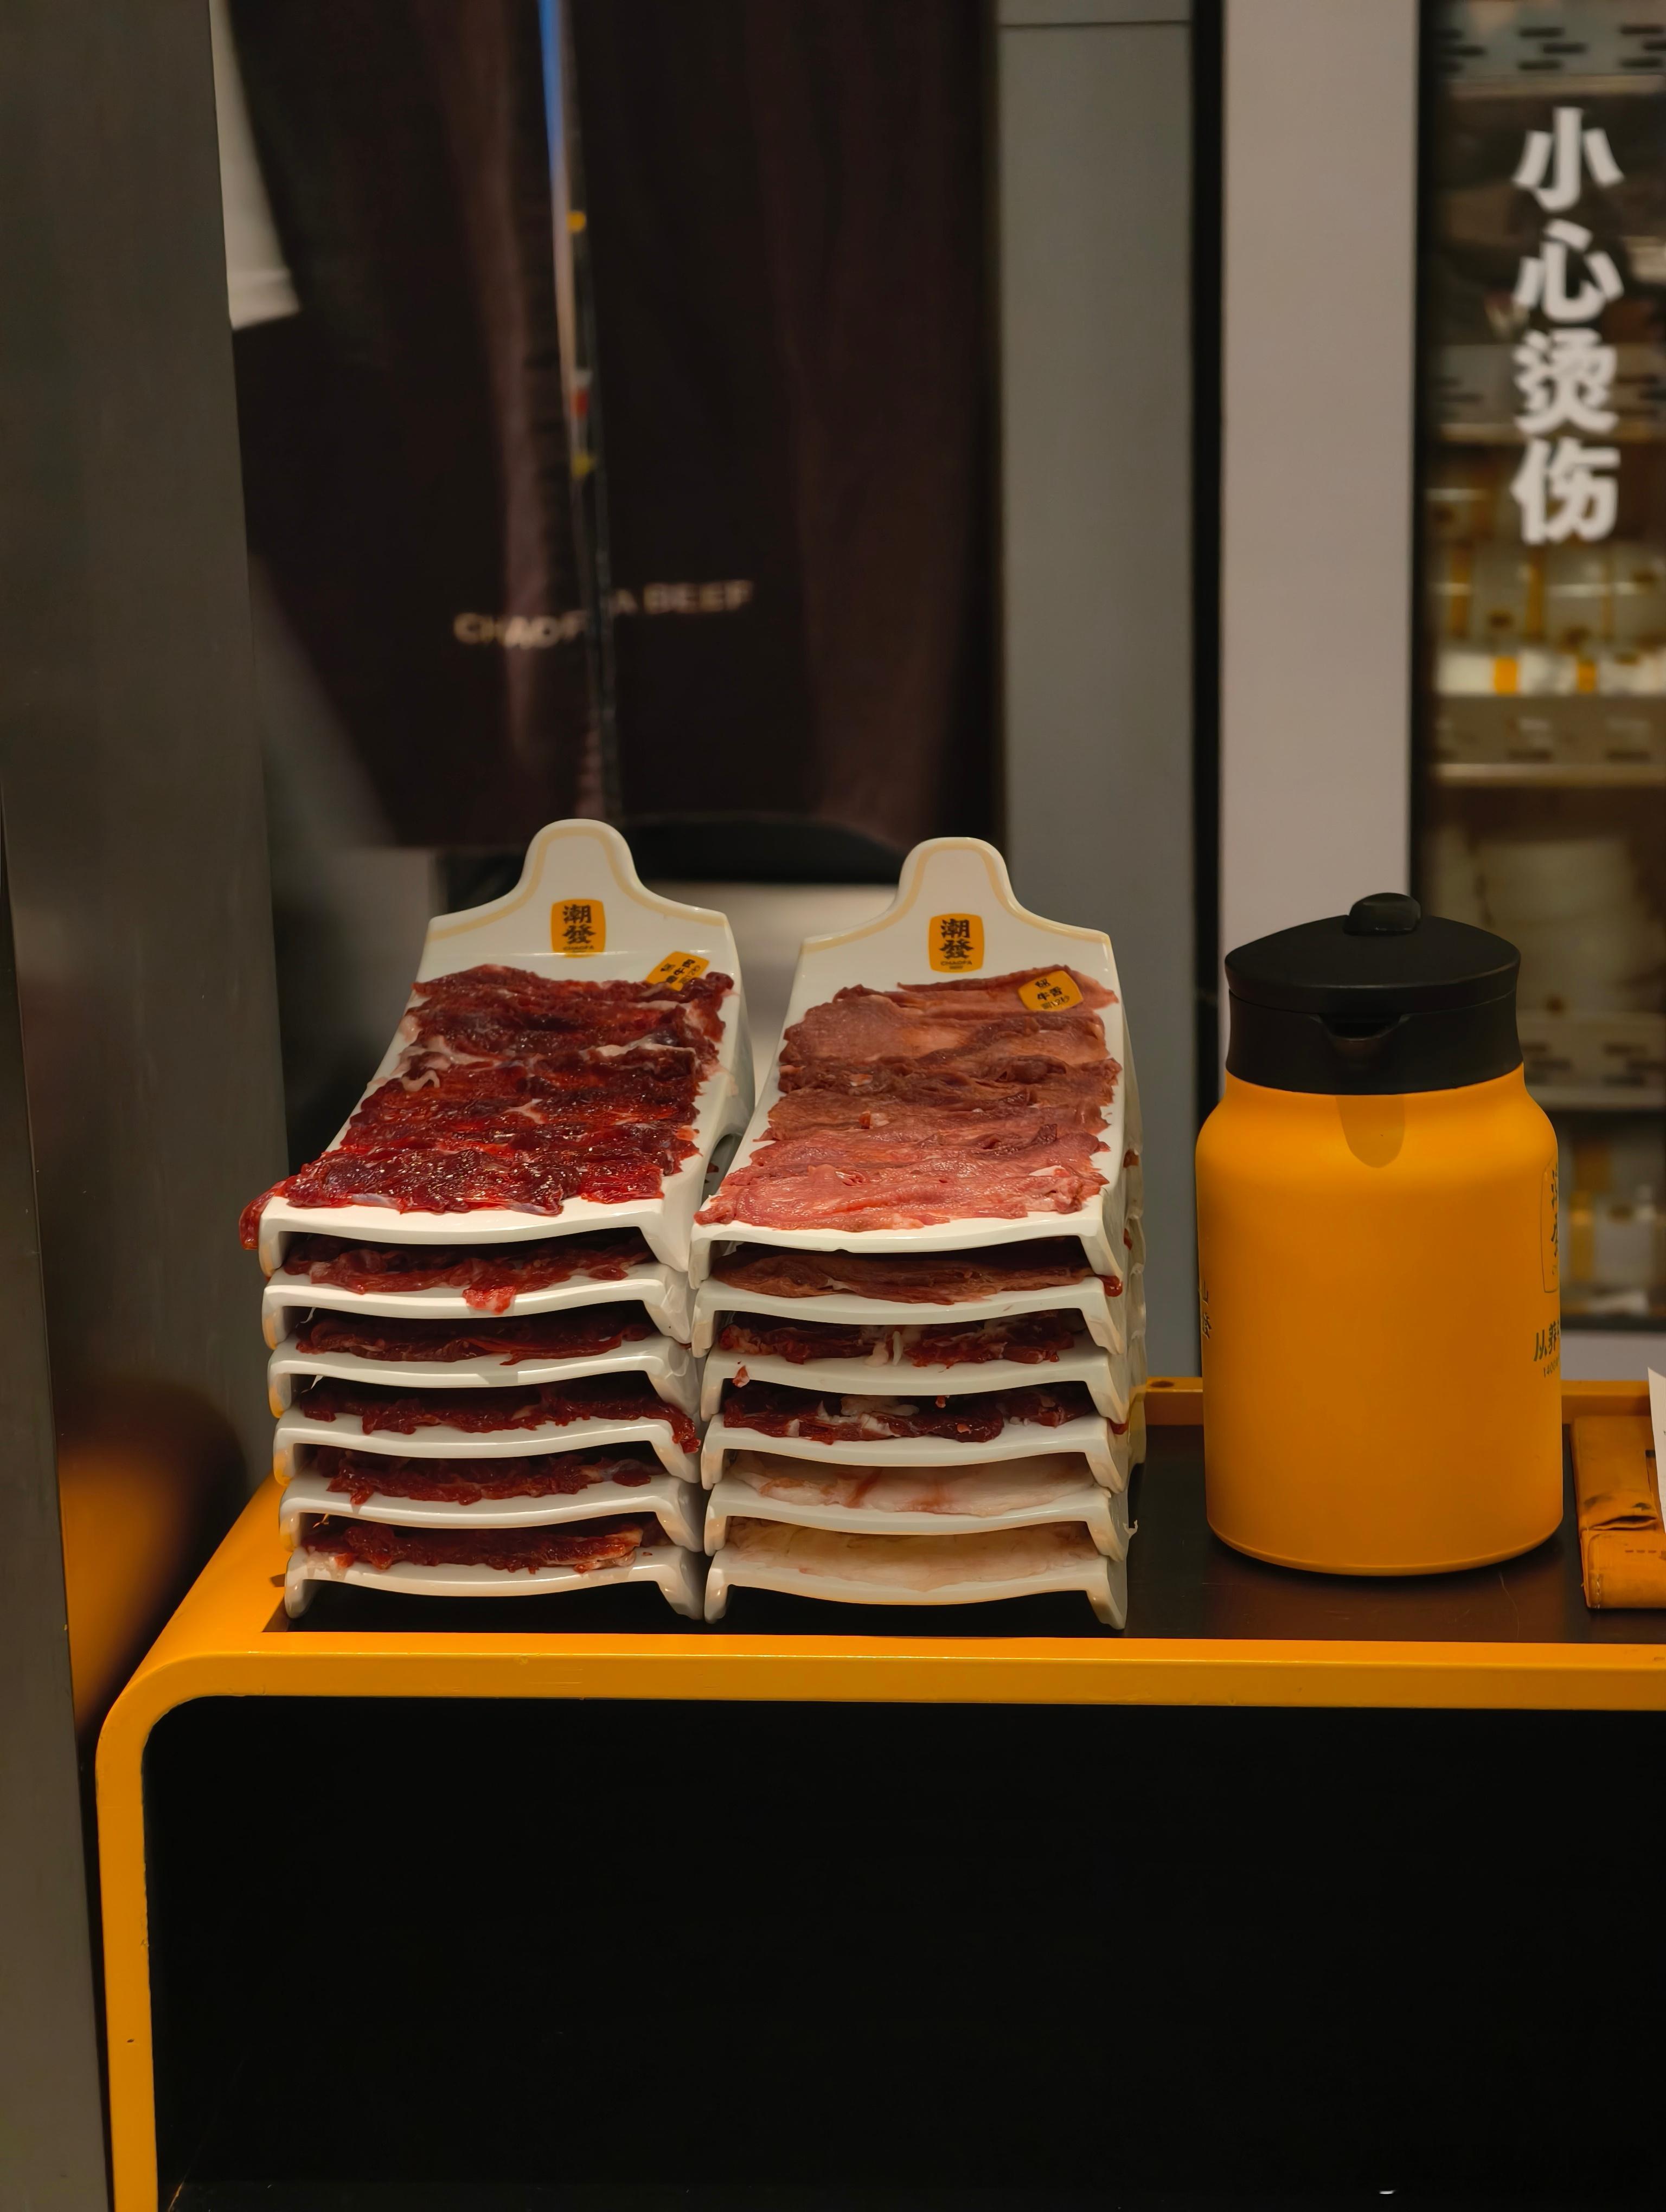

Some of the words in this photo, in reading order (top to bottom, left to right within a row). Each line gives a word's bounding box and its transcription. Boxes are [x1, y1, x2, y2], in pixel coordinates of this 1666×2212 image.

[1513, 107, 1624, 544] 小心烫伤
[643, 579, 754, 615] BEEF
[939, 918, 975, 959] 潮發
